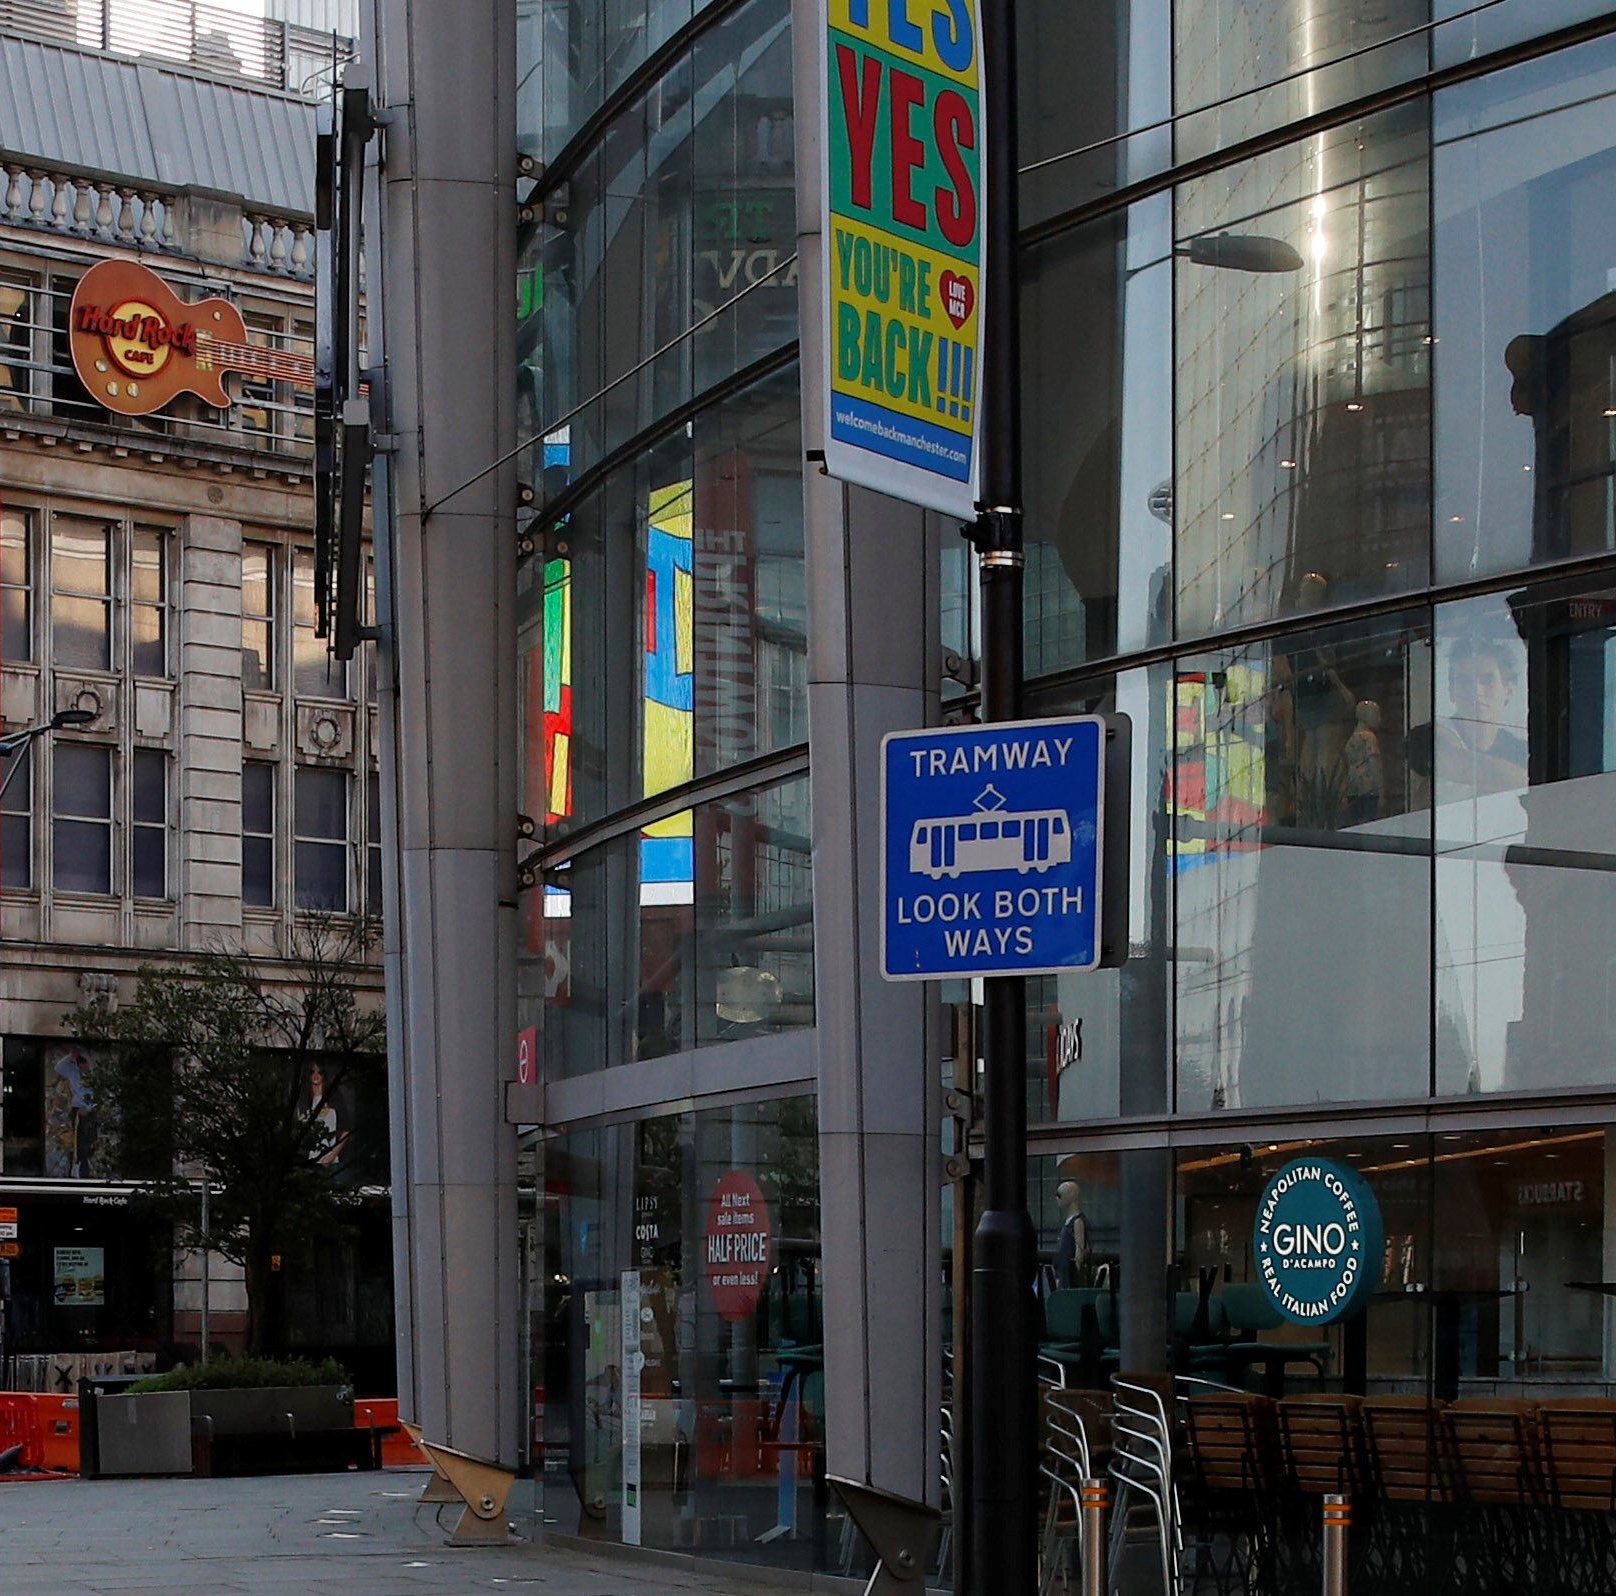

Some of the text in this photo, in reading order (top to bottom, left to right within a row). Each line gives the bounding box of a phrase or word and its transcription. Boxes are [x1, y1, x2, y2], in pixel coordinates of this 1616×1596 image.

[835, 44, 976, 248] YES
[836, 229, 932, 318] YOU'RE
[948, 279, 967, 300] LOVE
[948, 299, 967, 320] MCR
[78, 303, 197, 356] Hard Rock
[124, 350, 155, 365] CAFE
[837, 303, 972, 423] BACK!!!
[835, 409, 968, 467] welcomebackmanchester.com
[910, 736, 1074, 778] TRAMWAY
[897, 885, 1083, 924] LOOK BOTH
[944, 927, 1034, 958] WAYS
[717, 1210, 755, 1225] sale items
[1260, 1166, 1360, 1234] NEAPOLITAN COFFEE
[635, 1223, 660, 1241] COSTA
[708, 1231, 767, 1264] HALF PRICE
[1273, 1223, 1346, 1256] GINO
[1283, 1258, 1336, 1269] D'ACAMPO
[1261, 1256, 1358, 1316] REAL ITALIAN FOOD
